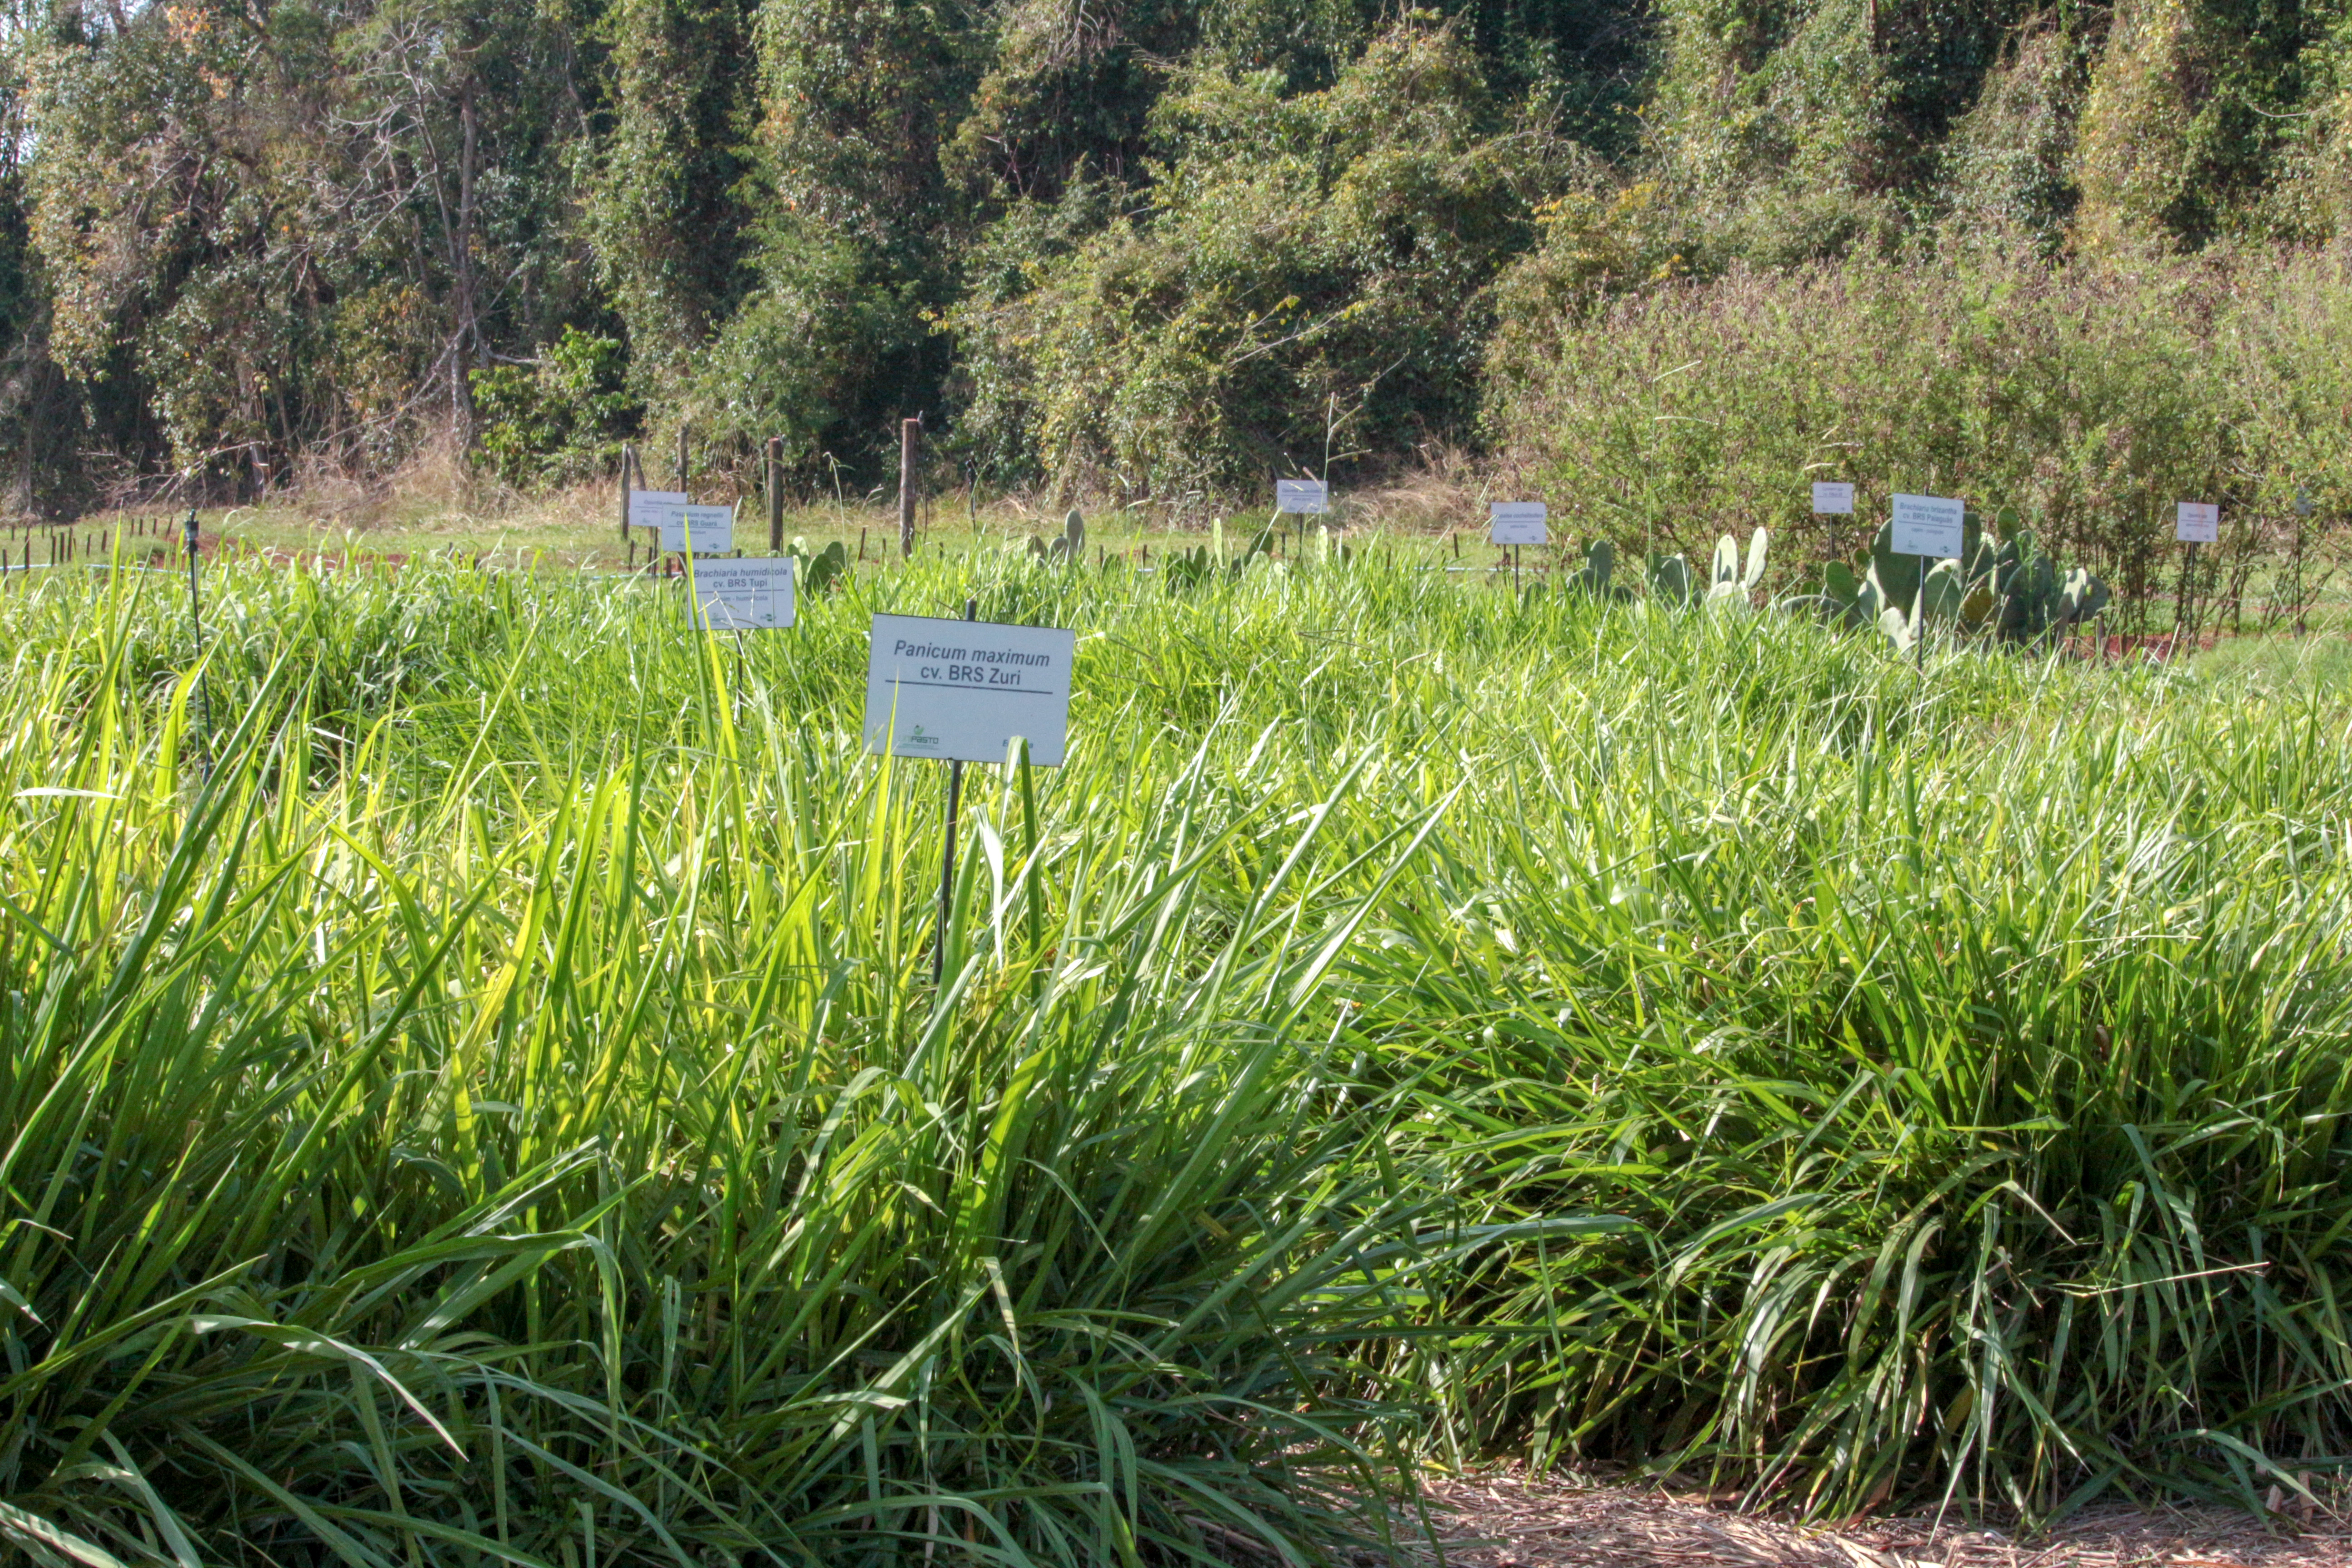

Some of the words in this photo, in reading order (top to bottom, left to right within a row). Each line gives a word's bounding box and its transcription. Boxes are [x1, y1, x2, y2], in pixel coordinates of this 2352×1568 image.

[1912, 512, 1926, 520] BRS
[694, 569, 737, 578] Brachiaria
[728, 579, 747, 587] BRS
[750, 578, 767, 588] Tupi
[894, 639, 966, 661] Panicum
[971, 648, 1050, 667] maximum
[921, 666, 942, 680] cv.
[949, 665, 984, 682] BRS
[989, 668, 1021, 686] Zuri
